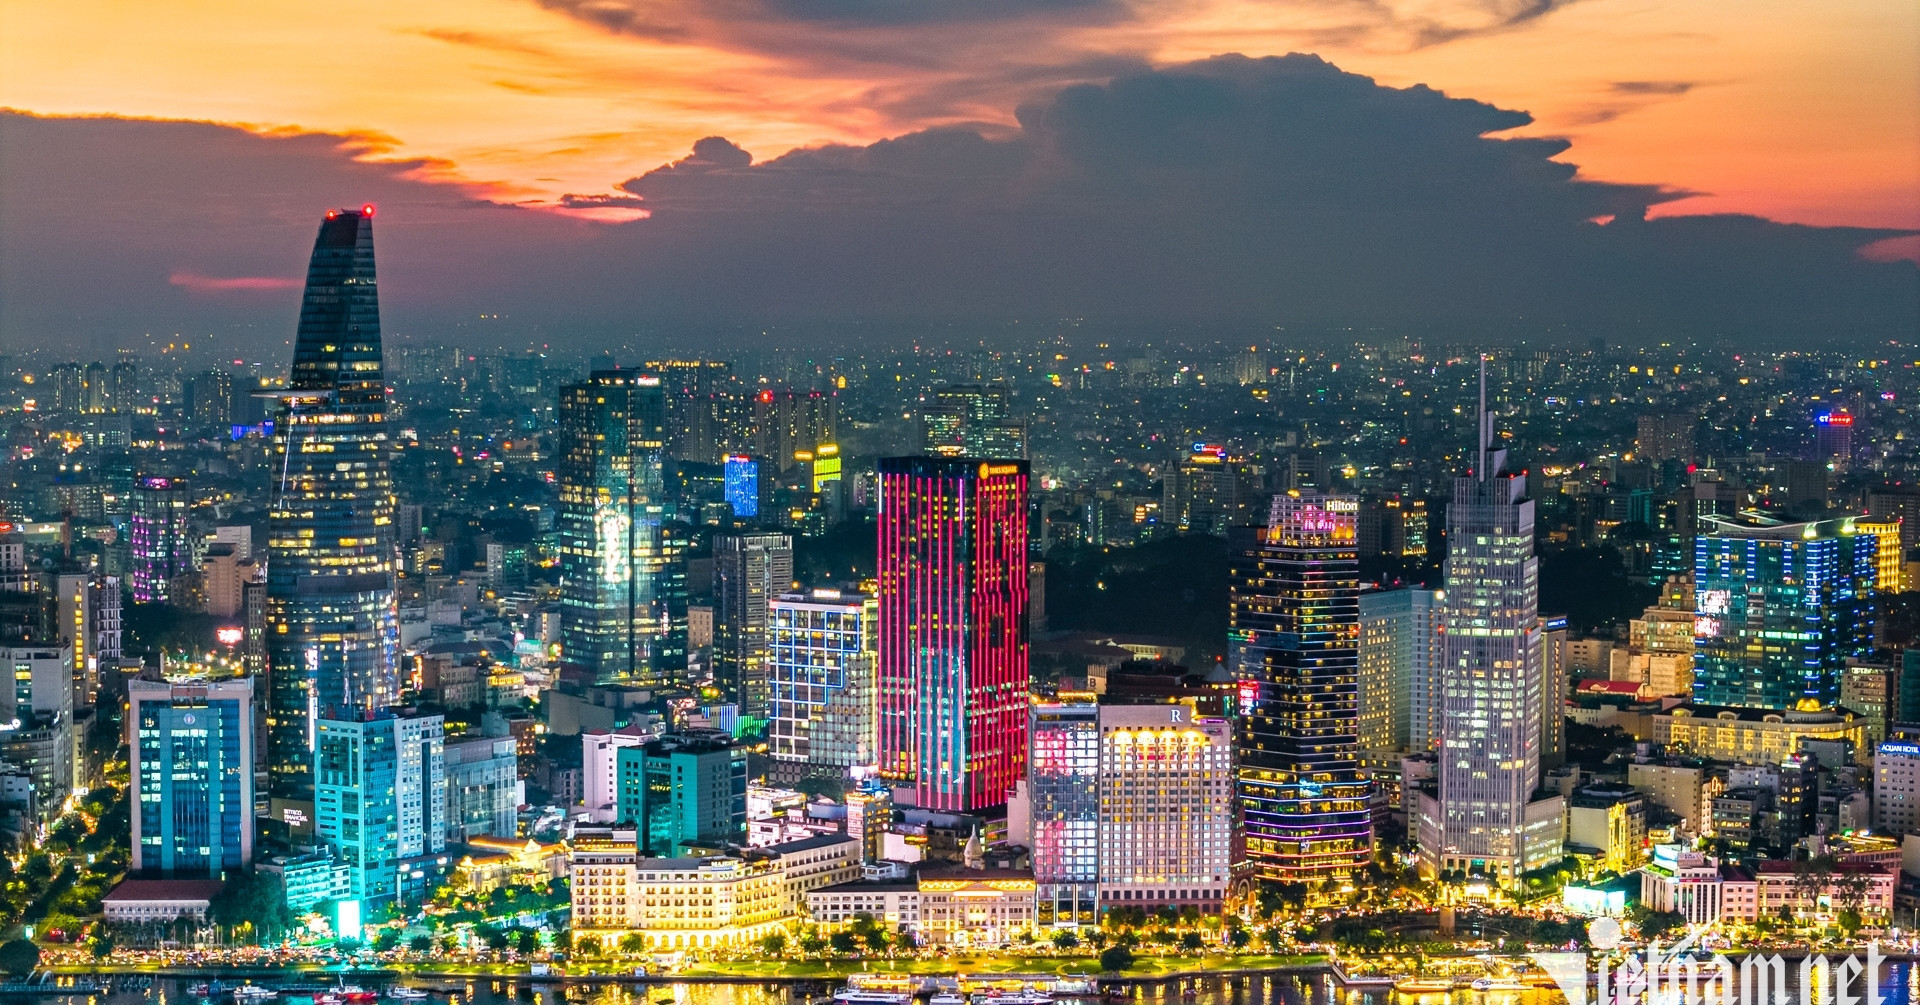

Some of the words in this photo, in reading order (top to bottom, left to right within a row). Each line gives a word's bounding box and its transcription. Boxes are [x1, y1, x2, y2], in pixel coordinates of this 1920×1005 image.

[1326, 500, 1358, 511] Hilton
[1089, 678, 1097, 688] B
[1170, 709, 1184, 722] R
